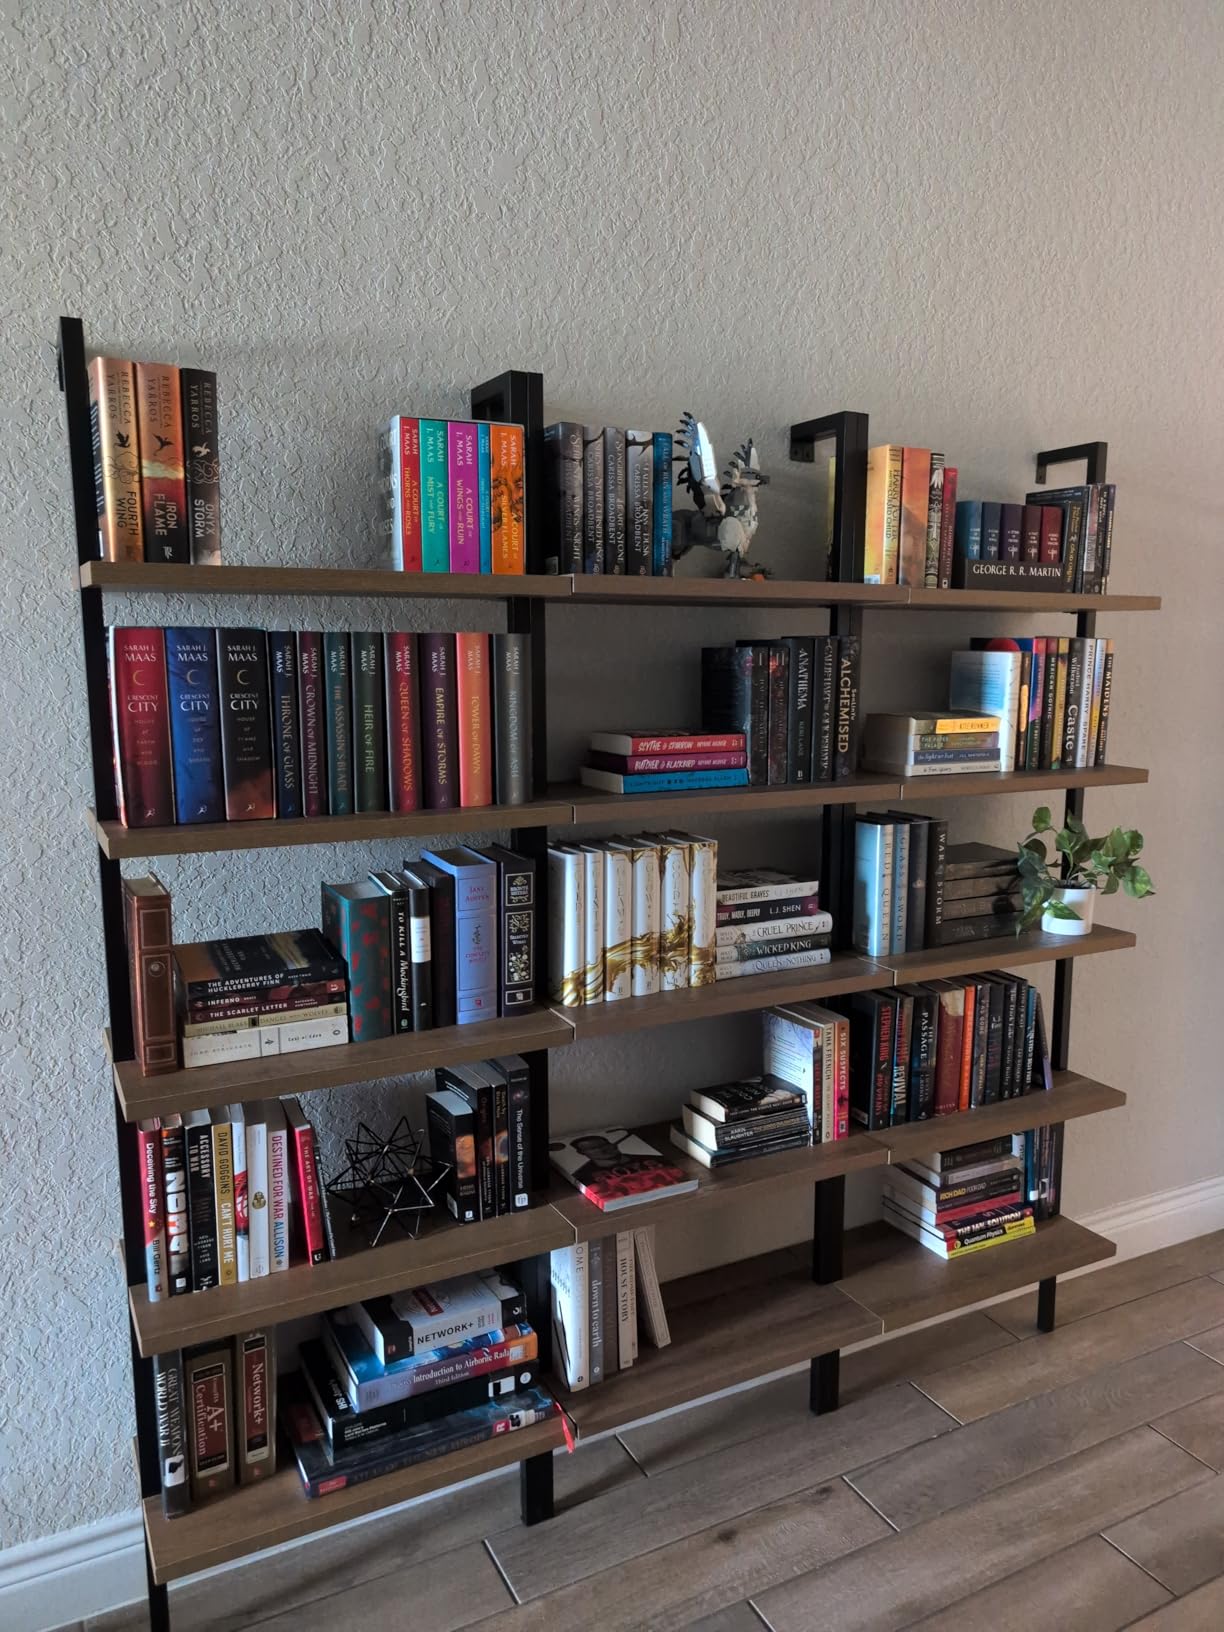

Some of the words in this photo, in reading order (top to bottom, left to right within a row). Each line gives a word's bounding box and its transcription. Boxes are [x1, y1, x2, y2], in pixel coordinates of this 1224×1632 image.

[106, 374, 117, 419] YARROS
[121, 372, 131, 424] REBECCA
[148, 378, 157, 422] YARROS
[162, 376, 172, 428] REBECCA
[190, 384, 199, 428] YARROS
[203, 382, 212, 434] REBECCA
[116, 498, 127, 528] WING
[128, 491, 139, 535] FOURTH
[154, 493, 168, 536] FLAME
[166, 502, 178, 528] IRON
[194, 499, 204, 538] STORM
[205, 504, 215, 534] ONYX
[973, 564, 1007, 575] GEORGE
[1009, 566, 1017, 576] R.
[1019, 567, 1027, 576] R.
[1030, 567, 1061, 576] MARTIN
[125, 653, 157, 661] MAAS
[178, 653, 208, 661] MAAS
[228, 653, 258, 661] MAAS
[276, 651, 284, 672] MAAS
[797, 650, 808, 710] ANATHEMA
[1070, 657, 1078, 694] Wilkerson
[128, 702, 158, 712] CITY
[180, 701, 209, 711] CITY
[230, 700, 258, 710] CITY
[400, 682, 409, 720] QUEEN
[838, 658, 851, 752] ALCHEMISED
[1102, 672, 1111, 717] MAIDENS
[364, 704, 373, 730] HEIR
[1065, 705, 1078, 750] Caste
[365, 750, 375, 773] FIRE
[402, 737, 412, 791] SHADOWS
[938, 834, 946, 861] WAR
[751, 890, 769, 898] GRAVES
[936, 881, 944, 925] STORM
[398, 912, 405, 922] TO
[782, 905, 800, 913] SHEN
[896, 896, 904, 941] SWORD
[757, 927, 783, 937] CRUEL
[786, 922, 814, 933] PRINCE
[757, 945, 789, 954] WICKED
[790, 941, 811, 950] KING
[208, 983, 260, 993] HUCKLEBERRY
[225, 975, 273, 986] ADVENTURES
[396, 960, 409, 1011] Mockingbird
[208, 997, 240, 1006] INFERNO
[227, 1007, 259, 1016] SCARLET
[262, 1003, 288, 1011] LETTER
[880, 1007, 890, 1042] STEPHEN
[921, 1012, 929, 1059] PASSAGE
[880, 1042, 889, 1061] KING
[893, 1066, 906, 1108] REVIVAL
[200, 1135, 210, 1178] ACCESSORY
[217, 1132, 228, 1156] DAVID
[272, 1136, 283, 1178] DESTINED
[146, 1142, 155, 1183] Deceiving
[219, 1159, 230, 1194] GOGGINS
[272, 1180, 284, 1197] FOR
[147, 1199, 158, 1214] Sky
[221, 1202, 232, 1226] CAN'T
[273, 1199, 284, 1219] WAR
[223, 1228, 232, 1249] HURT
[274, 1222, 284, 1258] ALLISON
[153, 1254, 161, 1275] Gertz
[223, 1251, 233, 1264] ME
[591, 1280, 602, 1308] down
[621, 1292, 629, 1322] STORY
[592, 1310, 600, 1319] to
[416, 1321, 474, 1346] NETWORK+
[592, 1321, 602, 1348] earth
[413, 1366, 454, 1383] Introduction
[464, 1354, 492, 1368] Airborne
[156, 1371, 168, 1411] WORLD
[168, 1368, 180, 1402] GREAT
[252, 1362, 265, 1424] Network+
[159, 1412, 170, 1436] WAR
[196, 1384, 208, 1456] Certification
[206, 1406, 224, 1432] A+
